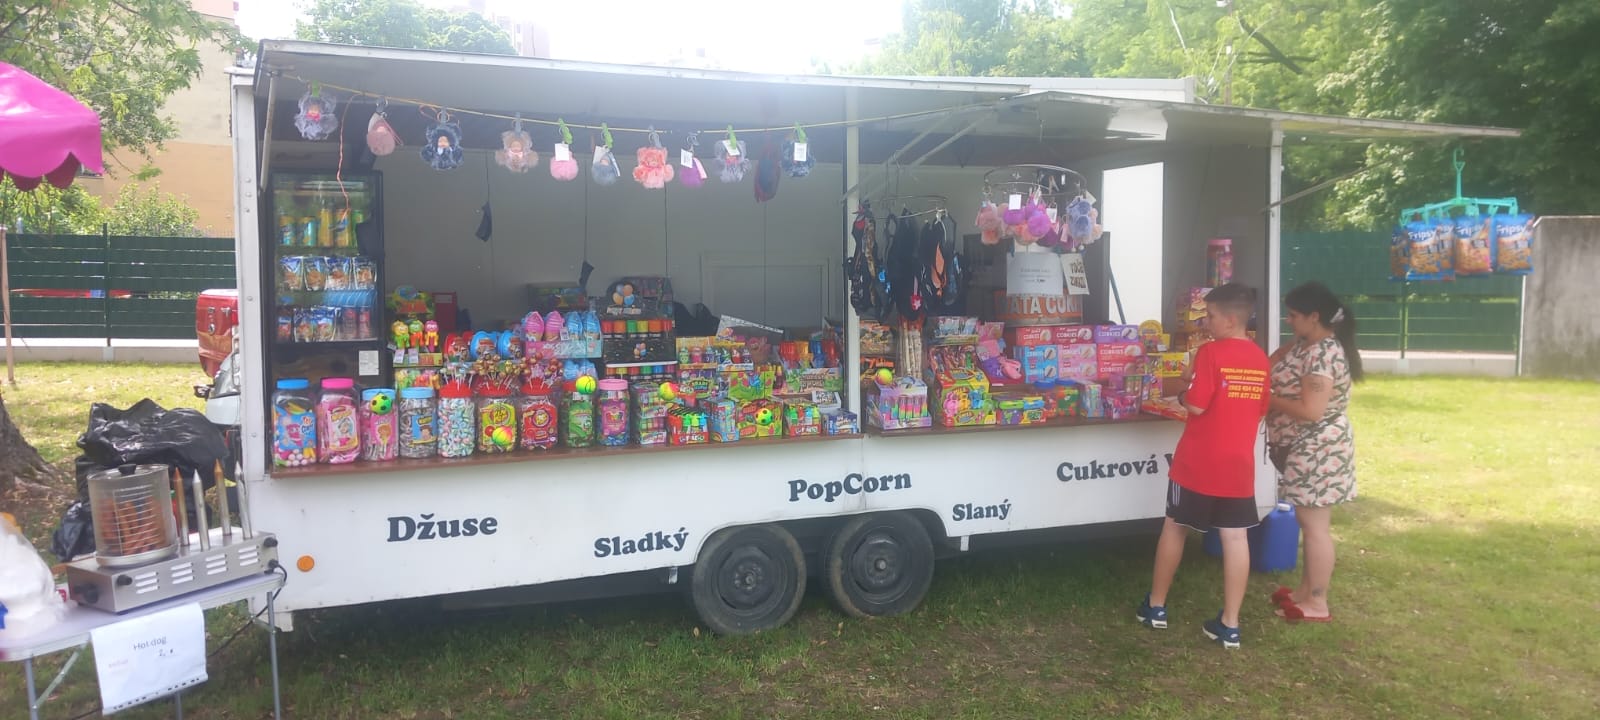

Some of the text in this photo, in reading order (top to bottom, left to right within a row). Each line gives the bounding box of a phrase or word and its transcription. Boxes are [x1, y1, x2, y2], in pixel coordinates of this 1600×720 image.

[1056, 454, 1159, 482] Cukrová
[788, 473, 912, 502] PopCorn
[952, 499, 1012, 521] Slaný
[387, 513, 499, 542] Džuse
[593, 527, 690, 558] Sladký
[133, 636, 167, 650] Hot dog
